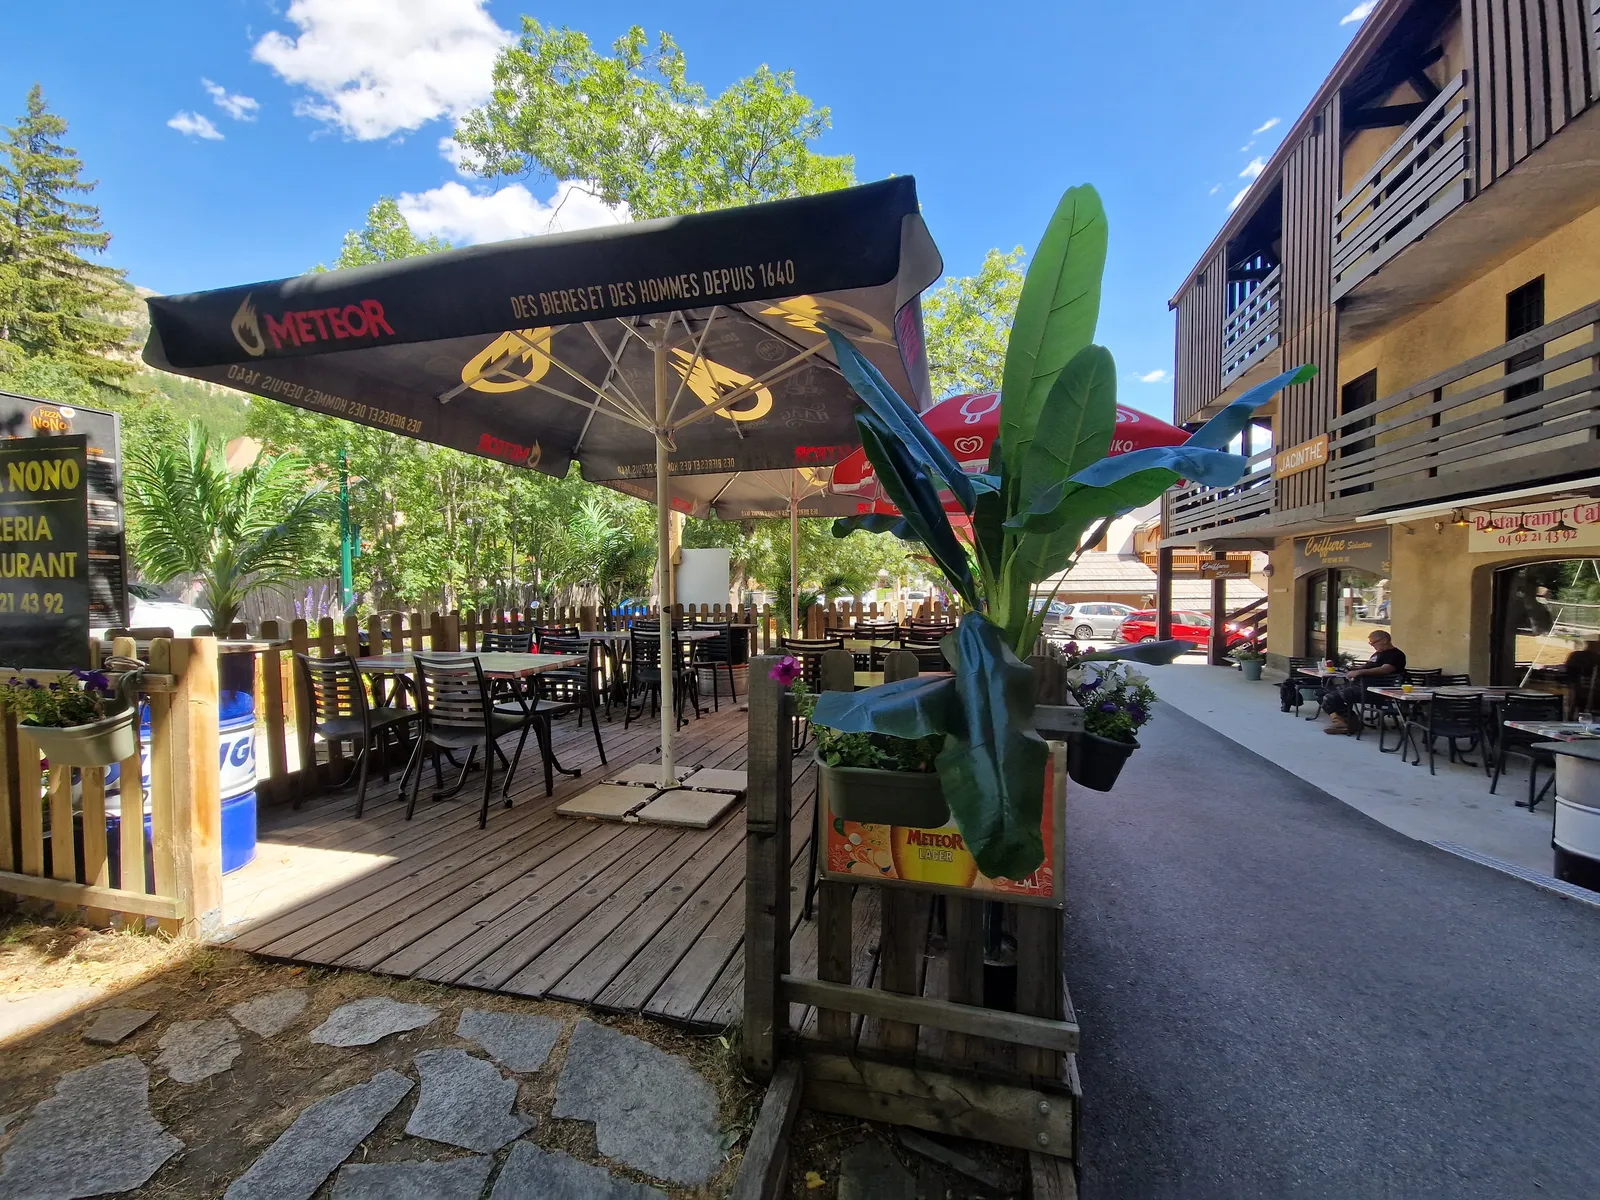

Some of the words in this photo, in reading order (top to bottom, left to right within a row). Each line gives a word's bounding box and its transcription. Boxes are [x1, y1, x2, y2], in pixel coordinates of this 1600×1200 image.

[510, 294, 538, 319] DES
[608, 282, 636, 307] DES
[638, 273, 700, 303] HOMMES
[703, 265, 755, 295] DEPUIS
[759, 259, 795, 288] 1640
[264, 299, 395, 348] METEOR
[40, 409, 62, 419] PIZZA
[1110, 440, 1133, 452] IKO
[1280, 441, 1323, 472] JACINTHE
[7, 458, 80, 492] NONO
[1304, 536, 1345, 558] Coiffure
[1498, 534, 1511, 546] 04
[1532, 532, 1541, 542] 21
[1563, 530, 1577, 542] 92
[0, 552, 78, 578] URANT
[1201, 562, 1230, 570] Coiffure
[21, 592, 39, 613] 43
[44, 592, 64, 614] 92
[907, 829, 964, 850] METEOR
[918, 848, 953, 862] LAGER
